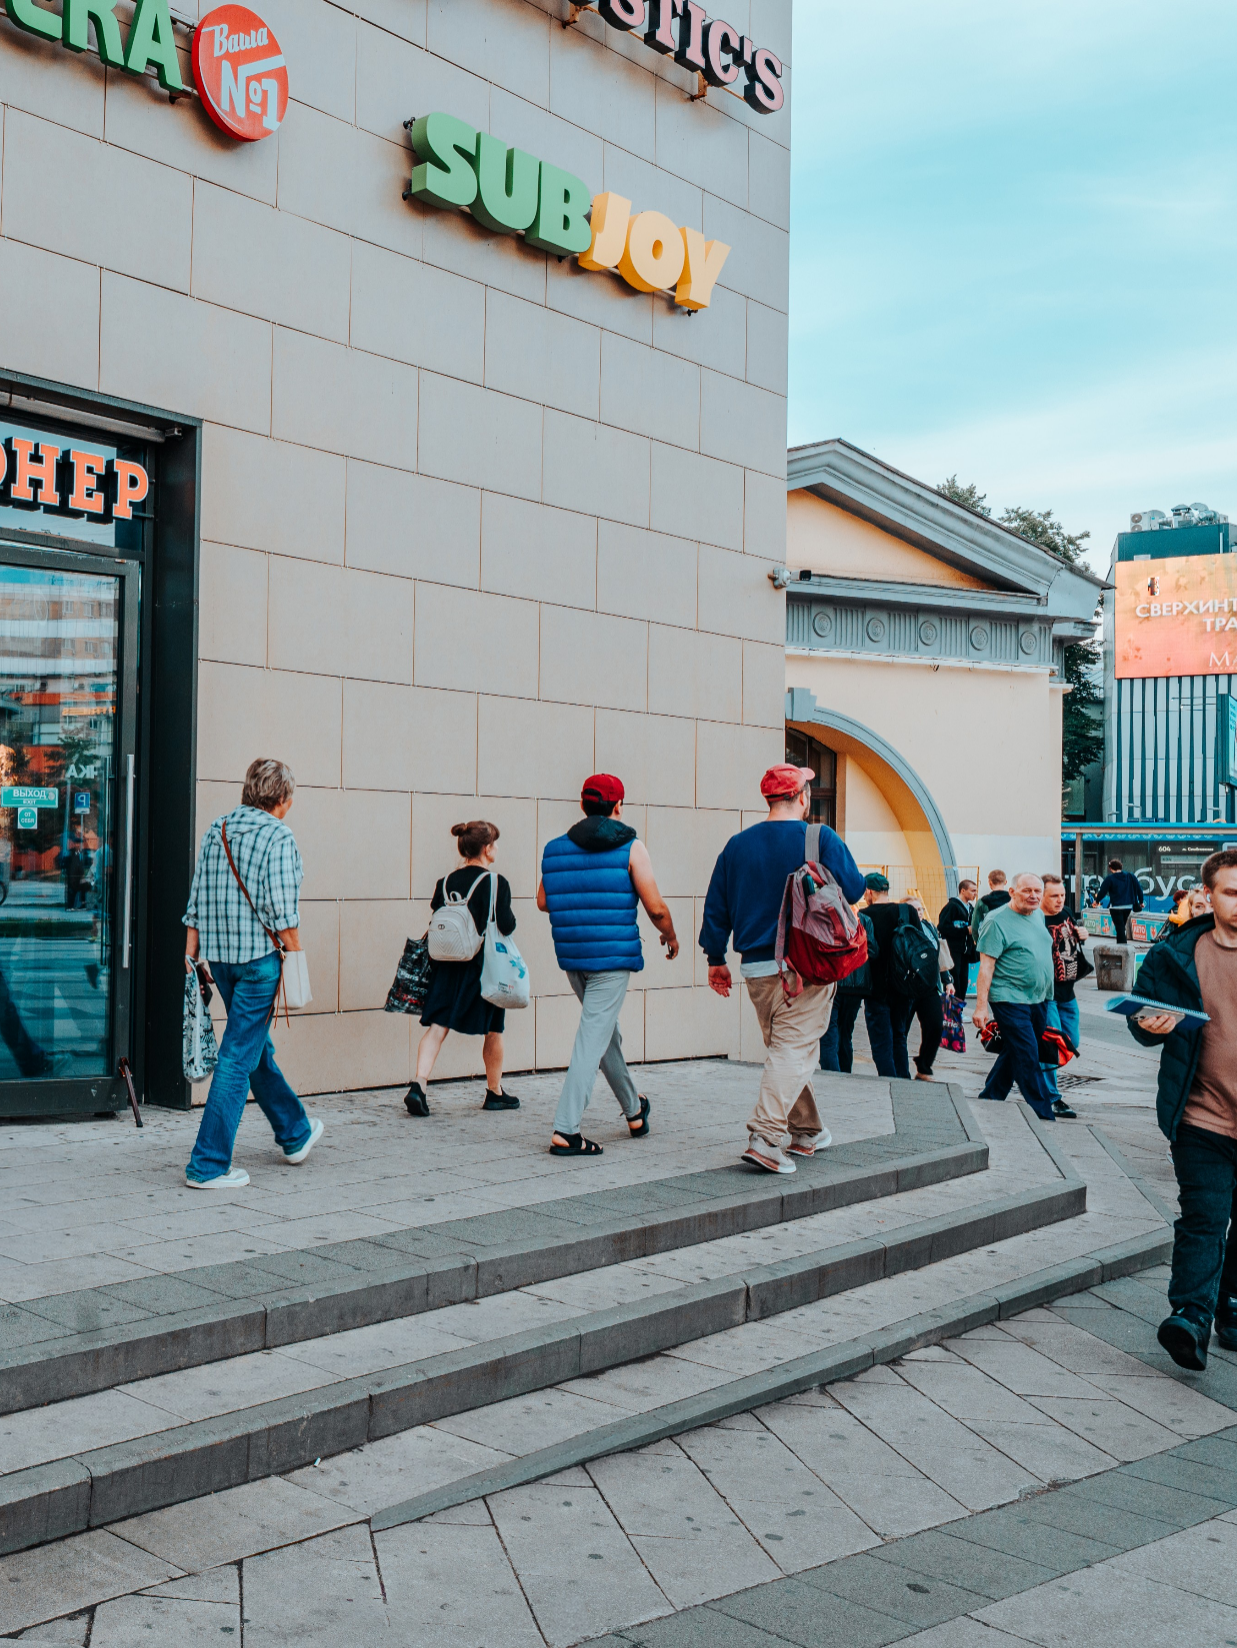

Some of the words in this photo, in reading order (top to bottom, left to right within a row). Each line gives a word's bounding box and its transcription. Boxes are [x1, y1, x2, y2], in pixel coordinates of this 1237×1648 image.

[210, 23, 269, 57] Ваша
[1136, 597, 1237, 618] СВЕРХИНТ
[12, 788, 47, 799] ВЫХОД
